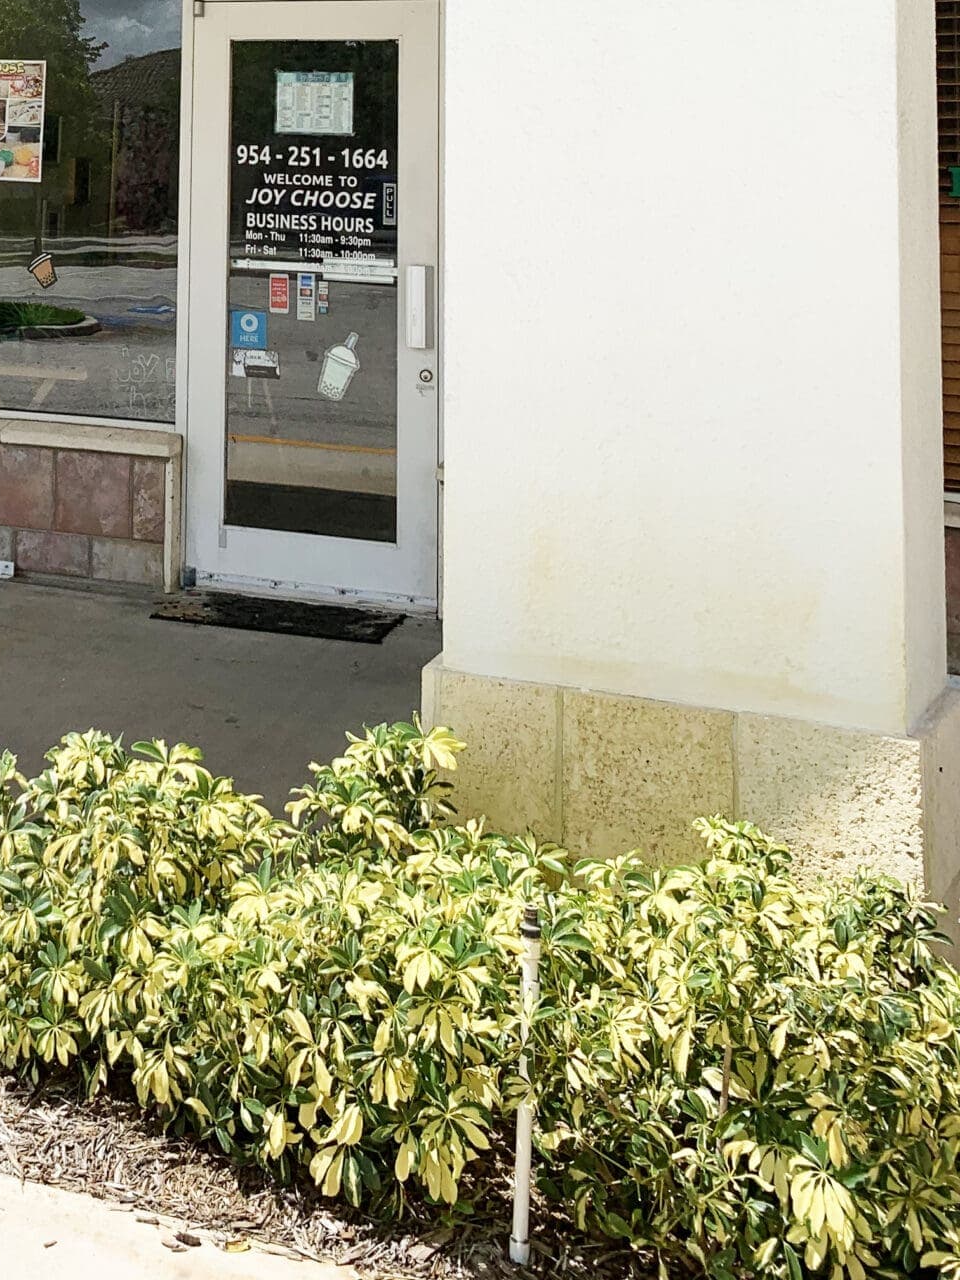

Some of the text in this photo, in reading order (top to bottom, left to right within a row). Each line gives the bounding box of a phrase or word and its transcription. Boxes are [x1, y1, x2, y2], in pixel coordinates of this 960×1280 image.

[236, 144, 271, 165] 954
[288, 146, 321, 167] 251
[341, 148, 389, 169] 1664
[263, 173, 358, 187] WELCOME TO
[245, 188, 377, 210] JOY CHOOSE
[246, 212, 374, 233] BUSINESS HOURS
[245, 230, 263, 241] Mon
[270, 231, 286, 242] Thu
[299, 233, 333, 244] 11:30am
[340, 235, 371, 249] 9:30pm
[245, 245, 257, 255] Fri
[263, 246, 277, 256] Sat
[299, 248, 333, 259] 11:30am
[340, 250, 376, 262] 10:00pm
[239, 334, 259, 343] HERE
